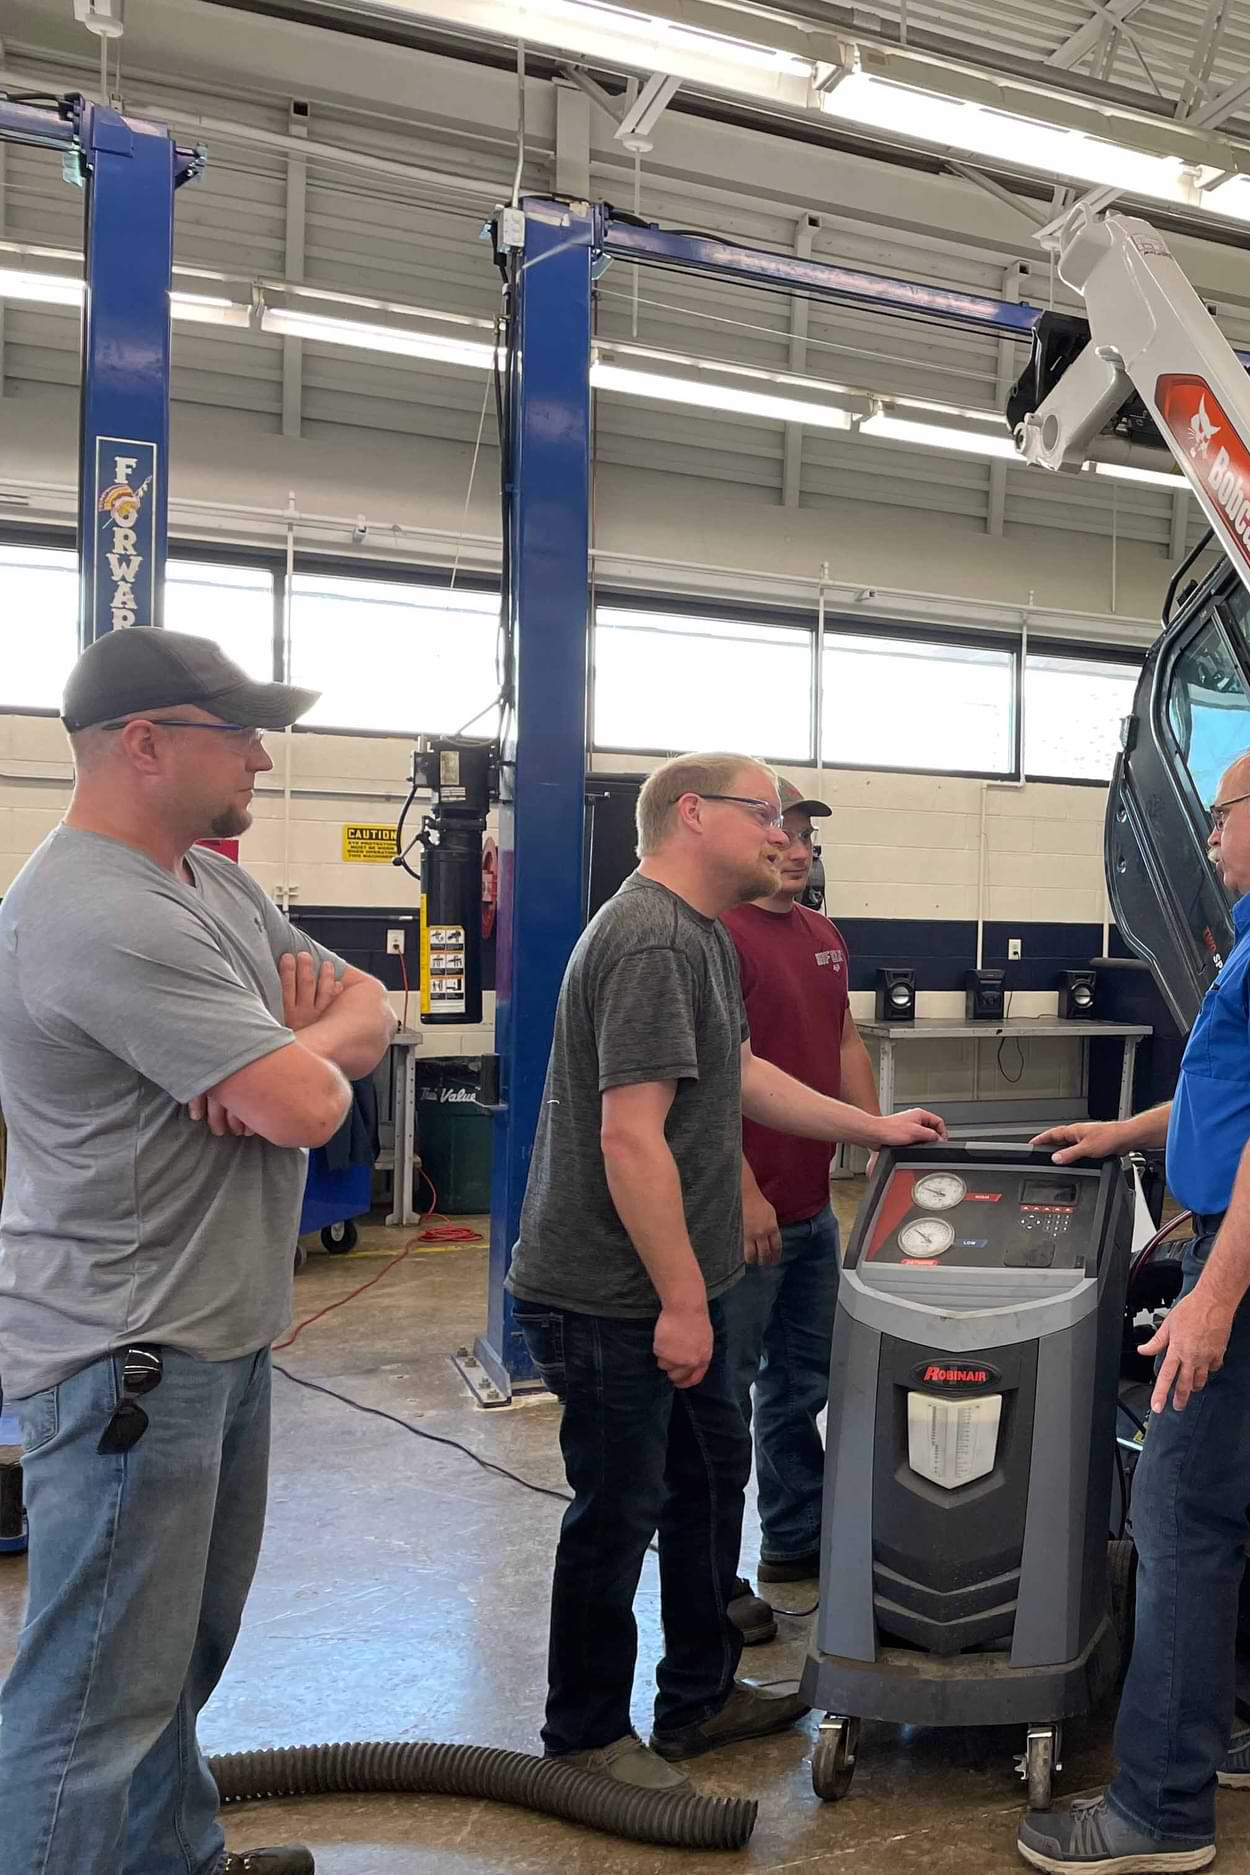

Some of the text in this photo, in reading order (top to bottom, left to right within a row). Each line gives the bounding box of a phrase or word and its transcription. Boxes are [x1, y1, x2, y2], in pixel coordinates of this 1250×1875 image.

[106, 456, 143, 631] FORWAR
[348, 829, 397, 840] CAUTION
[440, 1087, 476, 1103] Value
[923, 1366, 987, 1382] ROBINAIR
